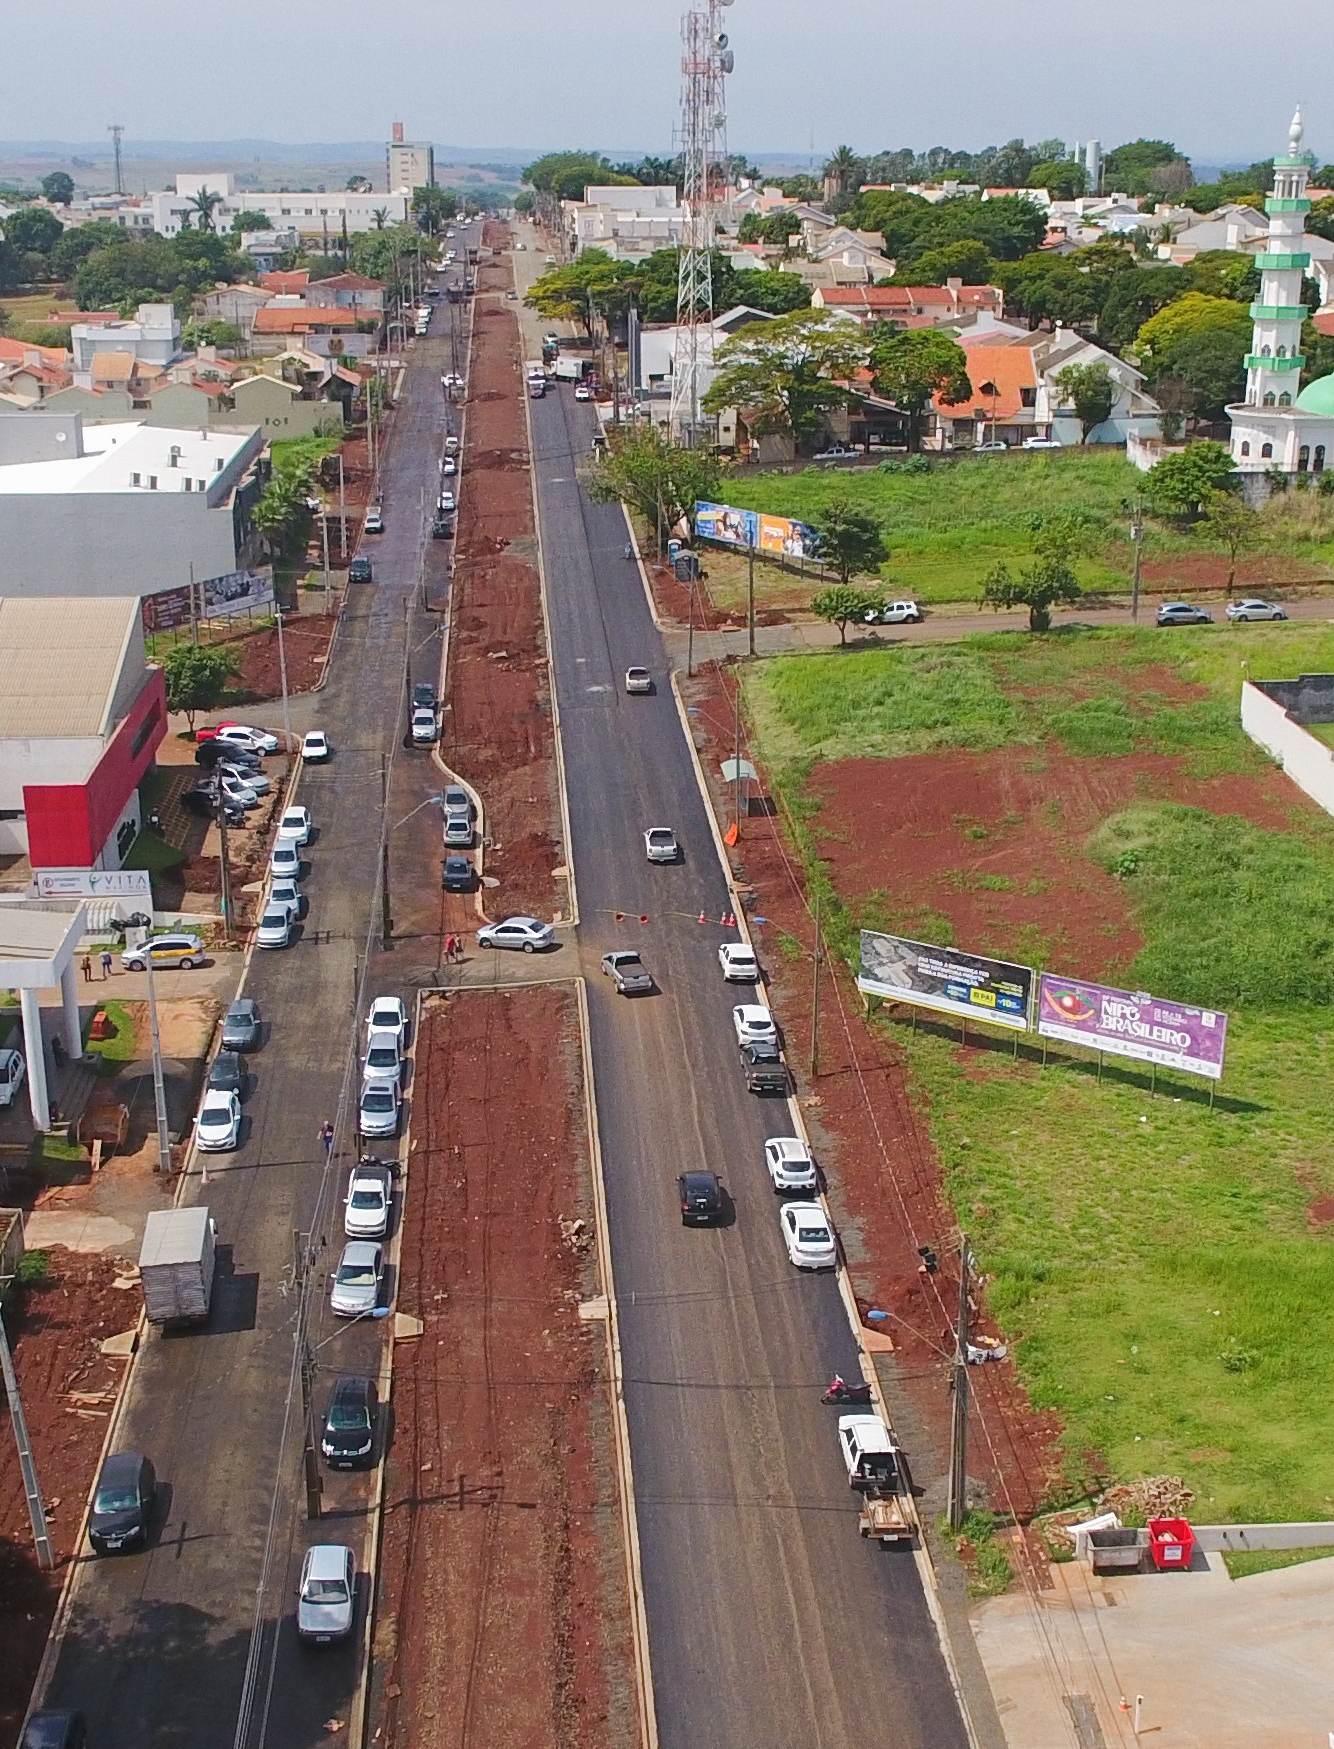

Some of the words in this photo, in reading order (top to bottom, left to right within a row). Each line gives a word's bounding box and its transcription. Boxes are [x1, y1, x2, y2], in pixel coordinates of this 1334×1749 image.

[105, 875, 147, 885] VITA
[1101, 1000, 1140, 1021] NIPO
[1100, 1015, 1192, 1048] BRASILEIRO
